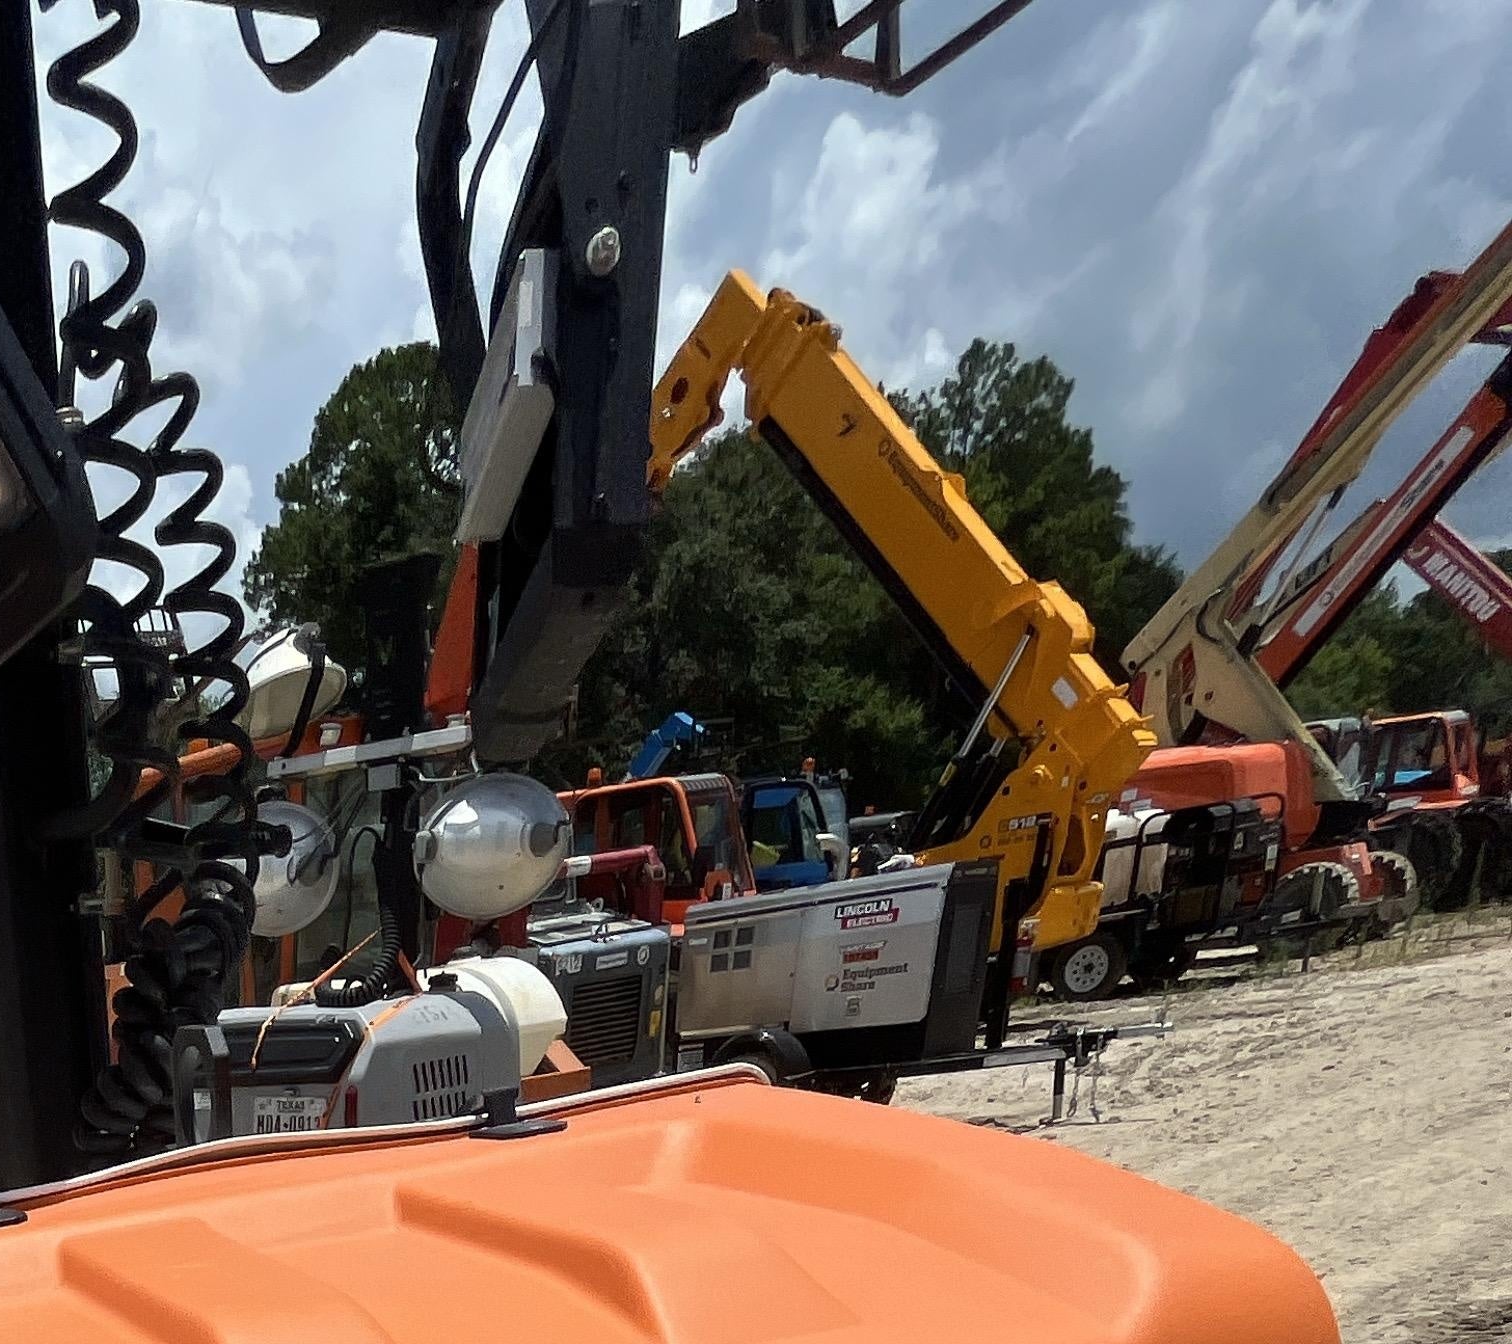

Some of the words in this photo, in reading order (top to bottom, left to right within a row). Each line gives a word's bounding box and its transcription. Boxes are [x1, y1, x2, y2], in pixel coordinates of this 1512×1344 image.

[1424, 551, 1501, 622] MANITOU
[837, 900, 890, 918] LINCOLN
[843, 963, 908, 981] Equipment
[840, 981, 876, 992] Share
